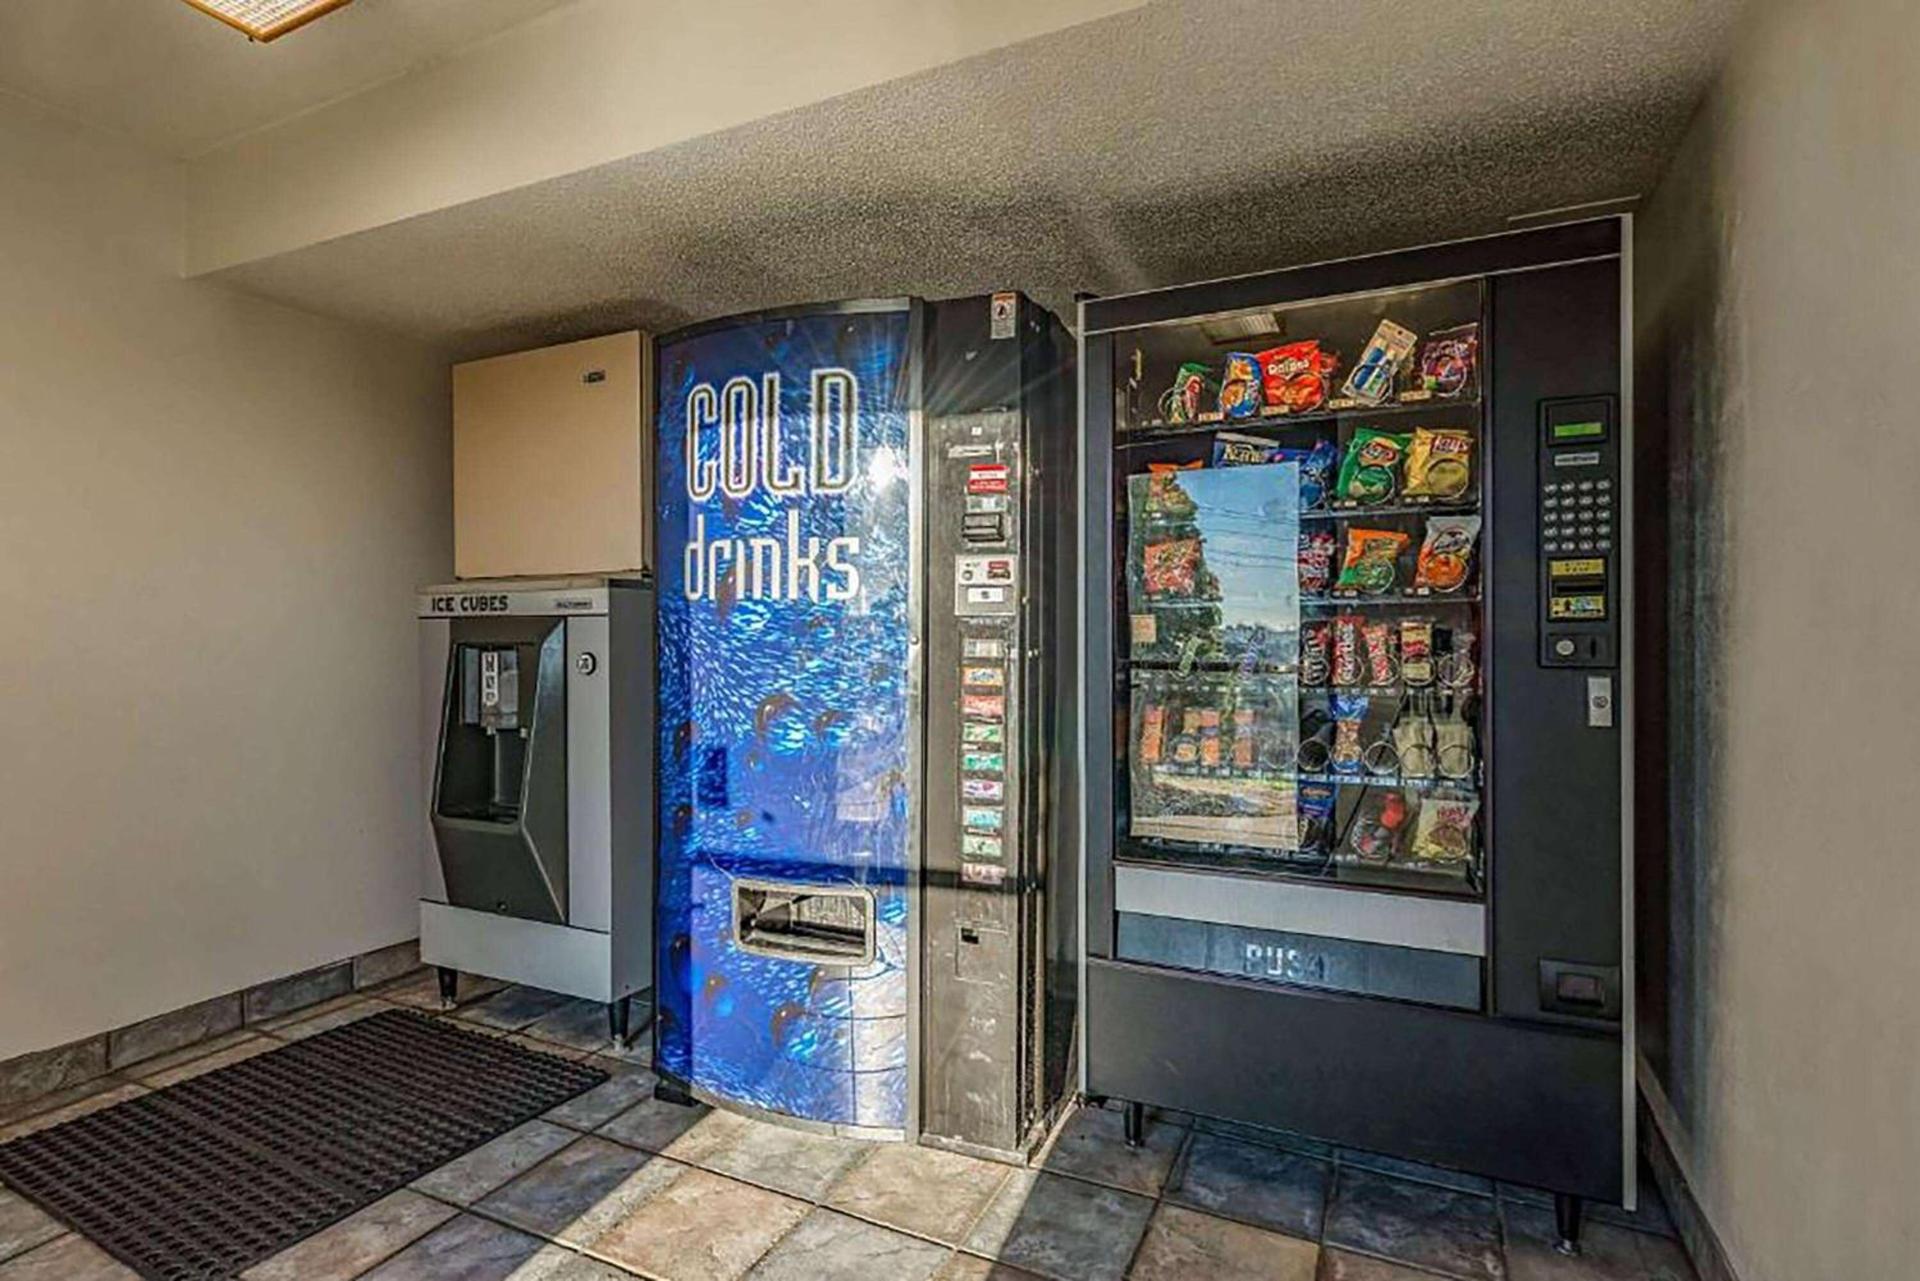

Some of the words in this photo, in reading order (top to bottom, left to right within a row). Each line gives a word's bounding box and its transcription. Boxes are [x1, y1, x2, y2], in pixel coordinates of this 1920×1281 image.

[687, 367, 857, 501] COLD
[684, 508, 860, 603] drinks
[432, 597, 455, 612] ICE
[460, 595, 509, 612] CUBES
